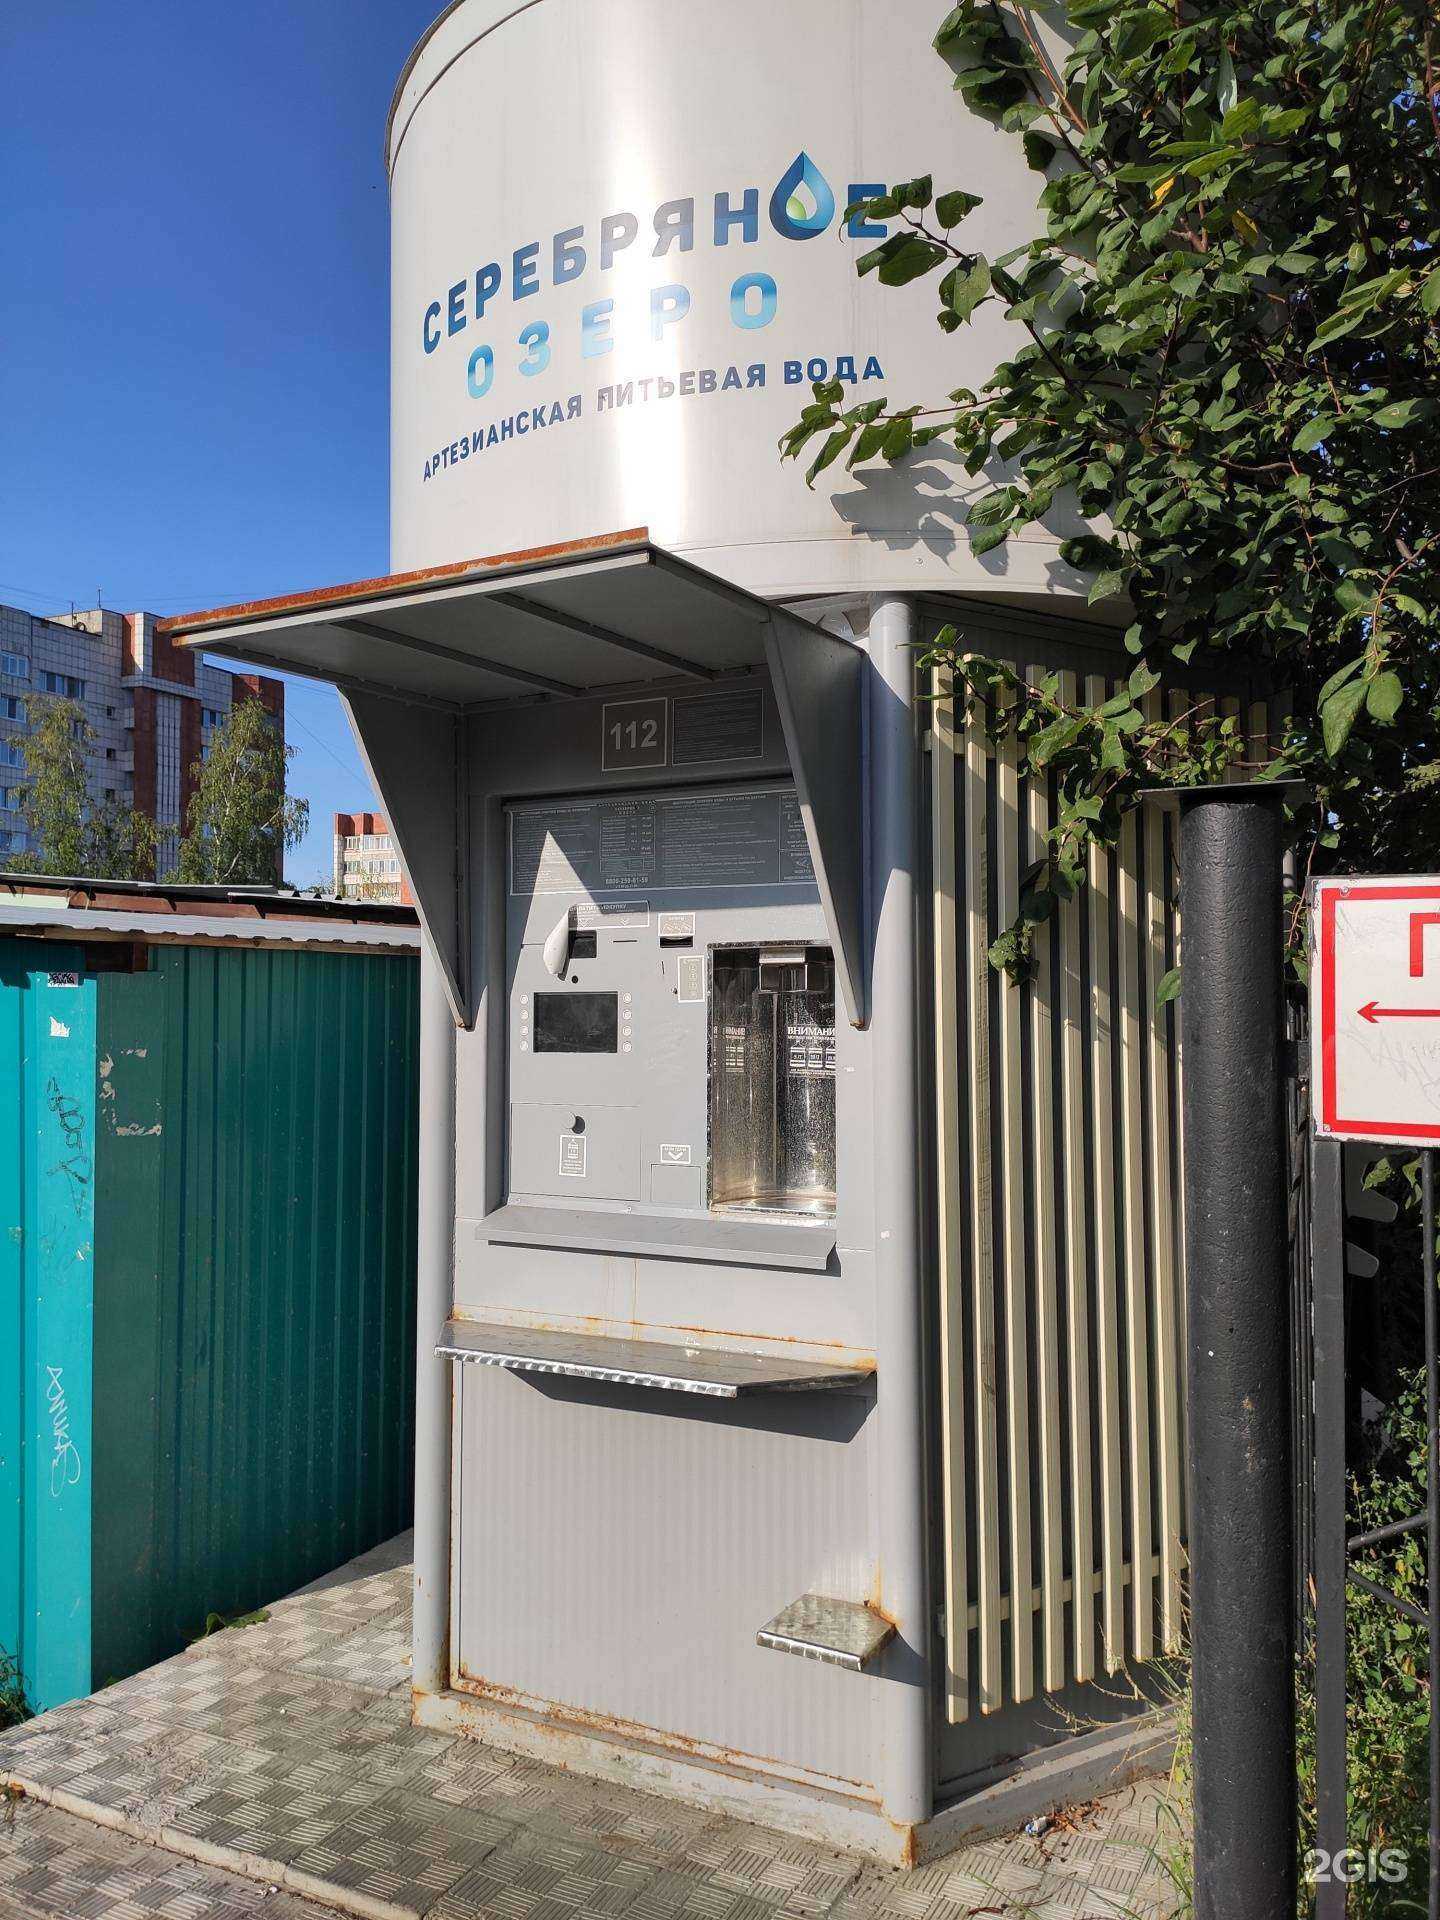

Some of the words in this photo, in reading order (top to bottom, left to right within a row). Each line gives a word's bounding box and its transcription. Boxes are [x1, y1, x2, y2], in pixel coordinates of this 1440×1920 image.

[423, 151, 888, 355] СЕРЕБРЯНОЕ
[467, 272, 778, 399] ОЗЕРО
[423, 395, 582, 481] АРТЕЗИАНСКАЯ
[597, 363, 766, 411] ПИТЬЕВАЯ
[783, 356, 885, 385] ВОДА
[610, 720, 657, 750] 112
[788, 1027, 835, 1036] ВНИМАНИ
